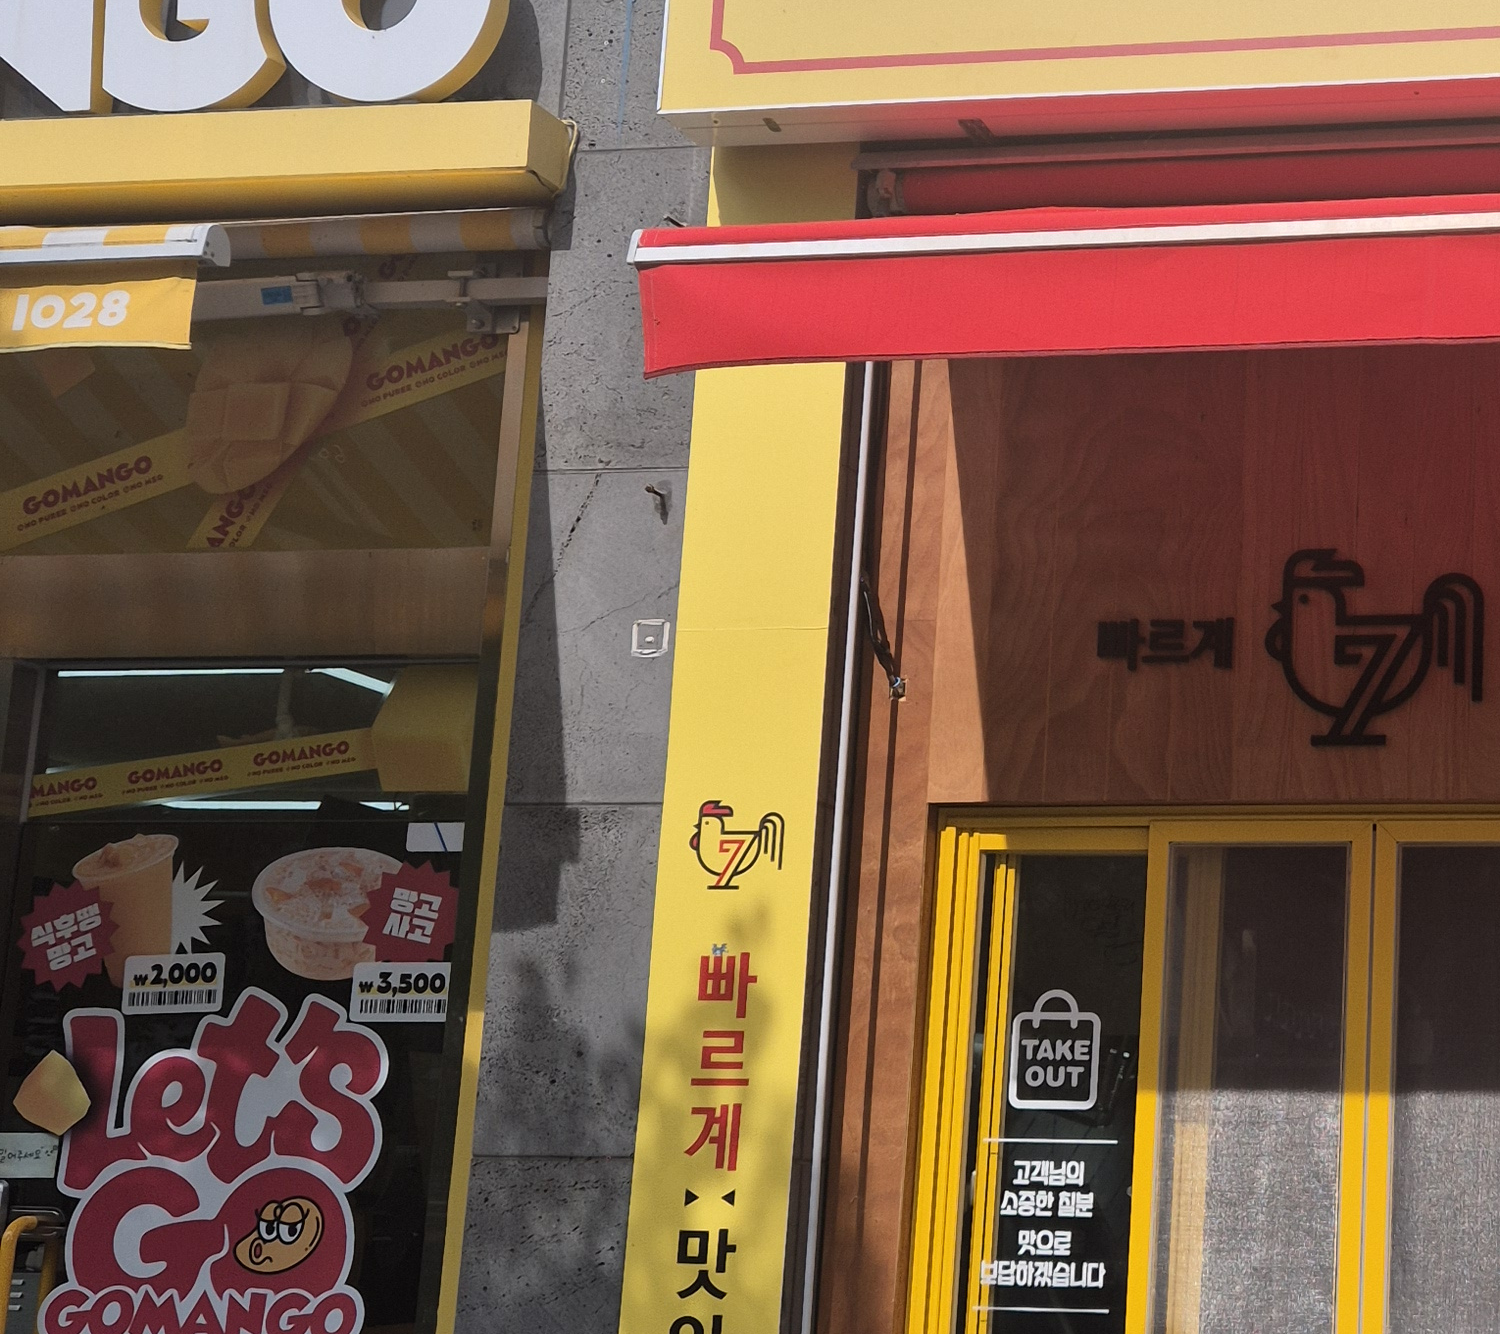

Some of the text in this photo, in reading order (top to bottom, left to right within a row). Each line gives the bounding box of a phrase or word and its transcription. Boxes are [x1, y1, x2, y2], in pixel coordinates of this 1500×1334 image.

[366, 333, 500, 391] GOMANGO
[23, 456, 152, 515] GOMANGO
[253, 740, 350, 767] GOMANGO
[127, 758, 224, 784] GOMANGO
[390, 887, 443, 919] 망고
[31, 902, 102, 948] 식후땡
[383, 916, 436, 945] 사고
[46, 936, 98, 971] 망고
[1021, 1039, 1091, 1061] TAKE
[1025, 1066, 1085, 1087] OUT
[1012, 1160, 1085, 1187] 고객님의
[1000, 1191, 1094, 1218] 소중한 칠분
[72, 1167, 347, 1299] GO
[1018, 1230, 1072, 1257] 맛으로
[980, 1261, 1106, 1289] 보답하겠습니다
